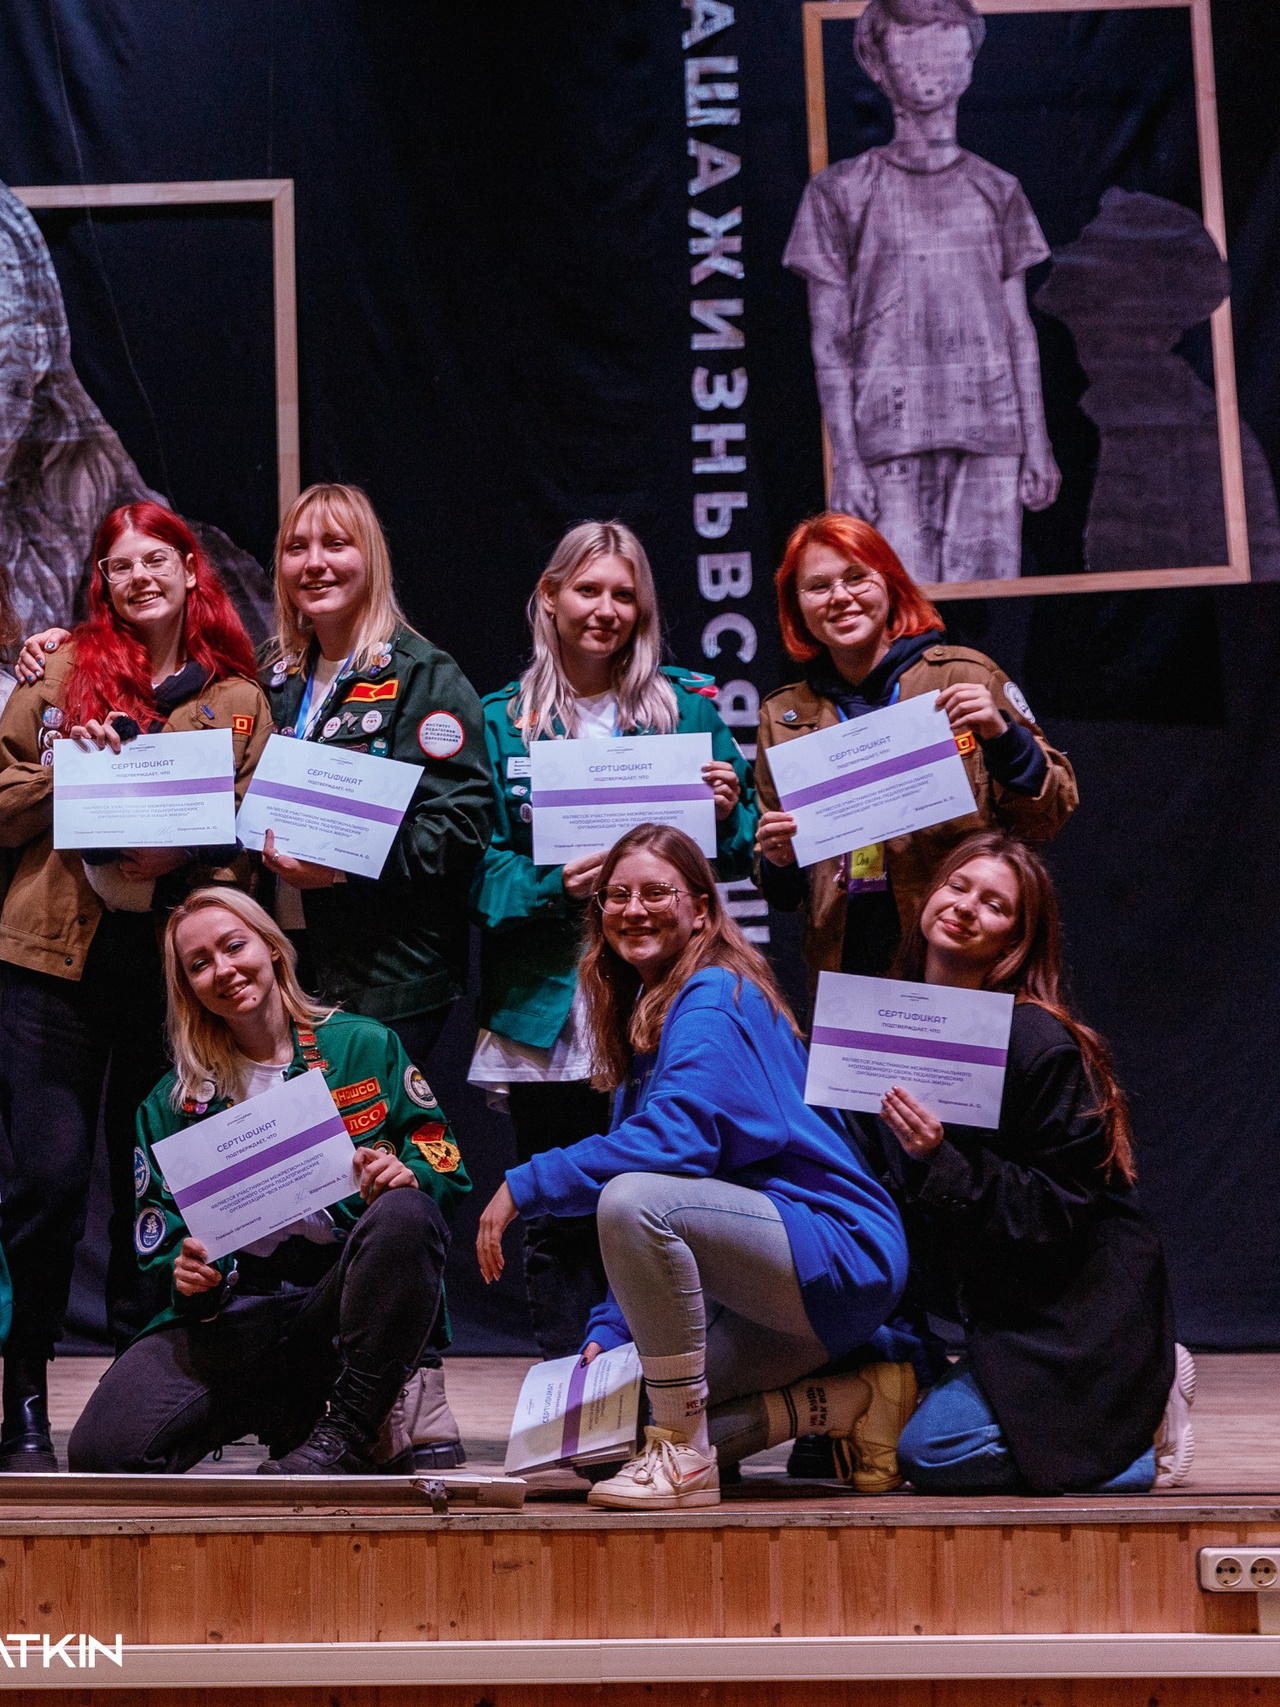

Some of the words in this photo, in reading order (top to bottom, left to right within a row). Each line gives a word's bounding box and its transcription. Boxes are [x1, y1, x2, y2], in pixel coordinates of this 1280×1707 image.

[829, 735, 892, 762] СЕРТИФИКАТ
[110, 760, 176, 769] СЕРТИФИКАТ
[589, 763, 653, 773] СЕРТИФИКАТ
[306, 768, 364, 786] СЕРТИФИКАТ
[878, 1009, 948, 1025] СЕРТИФИКАТ
[349, 1109, 381, 1130] ЛСО
[216, 1119, 278, 1153] СЕРТИФИКАТ
[225, 1137, 267, 1161] ПОДТВЕРЖДАЕТ,
[267, 1132, 278, 1141] ЧТО
